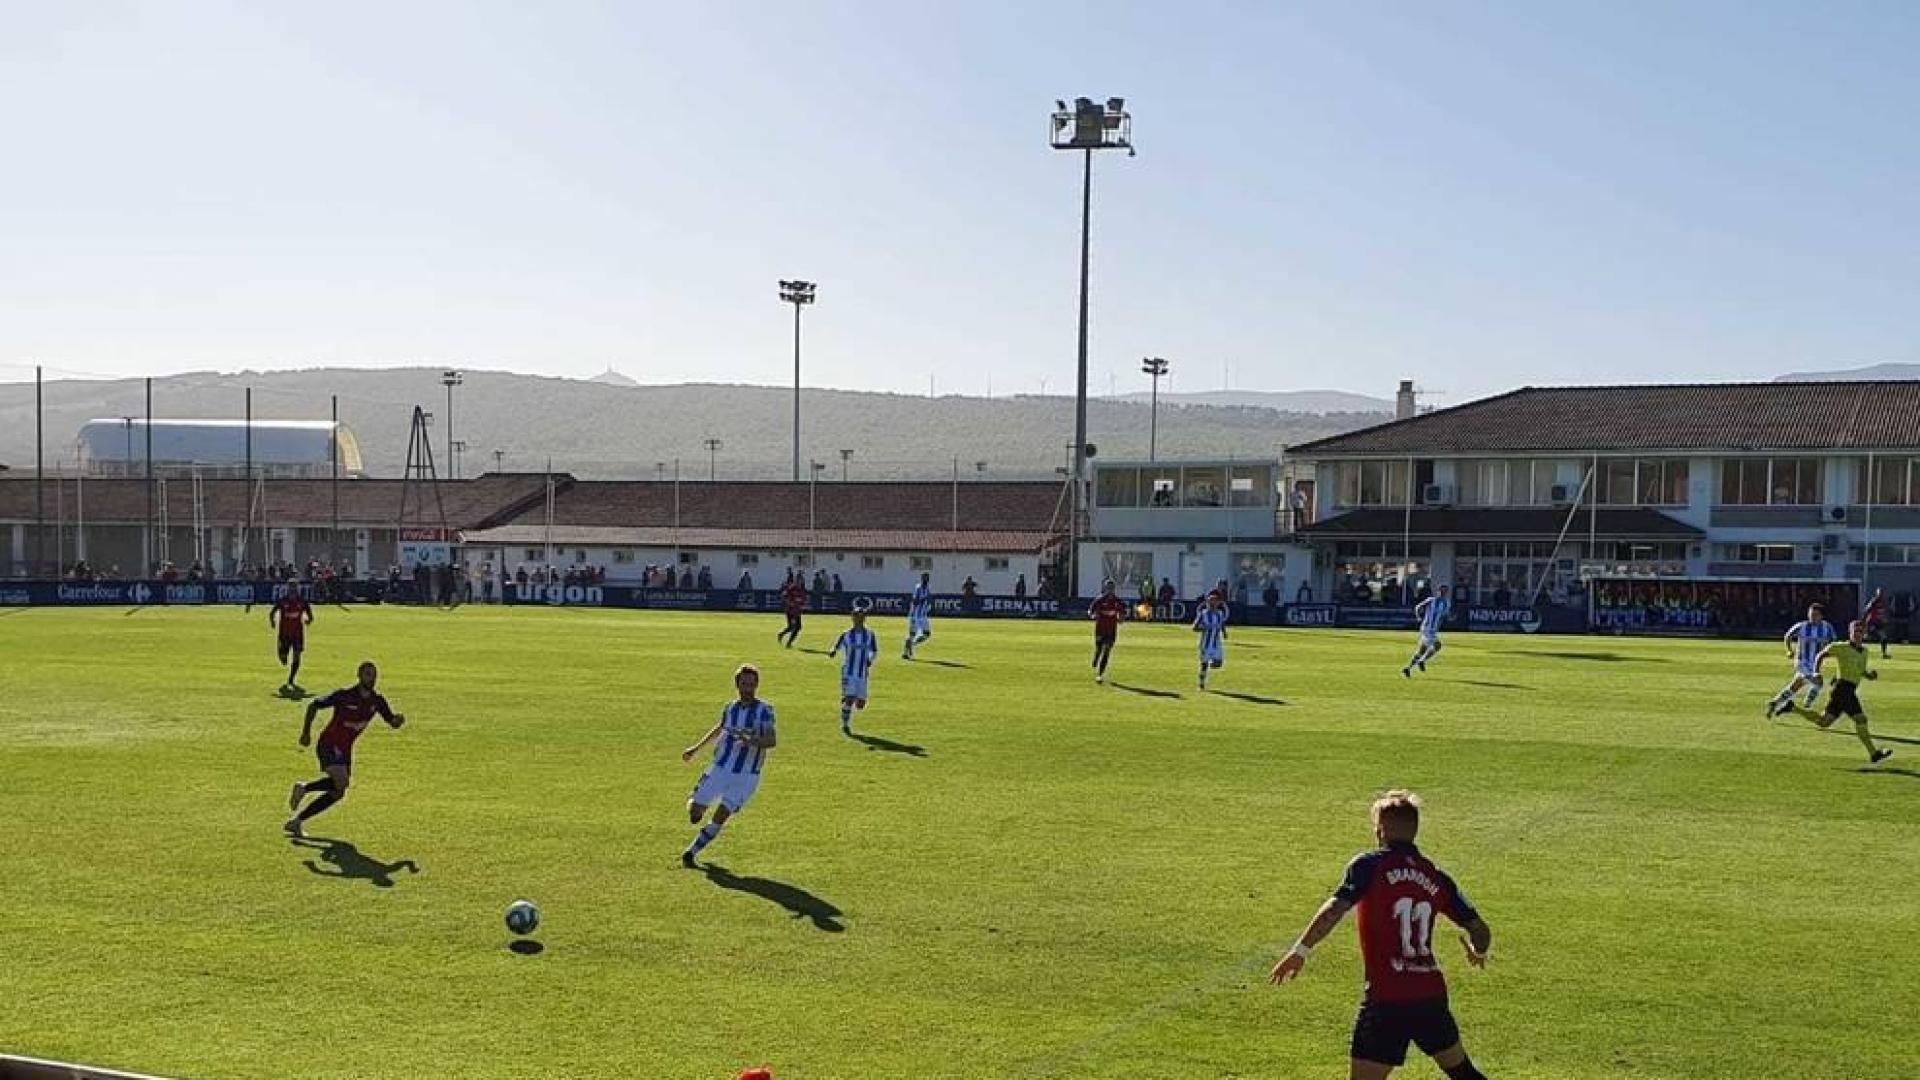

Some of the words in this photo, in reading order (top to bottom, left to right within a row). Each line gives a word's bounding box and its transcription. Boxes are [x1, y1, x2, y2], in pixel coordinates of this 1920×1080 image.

[57, 583, 121, 600] Carrefour
[1386, 868, 1440, 897] BRANDON
[1392, 897, 1432, 958] 11
